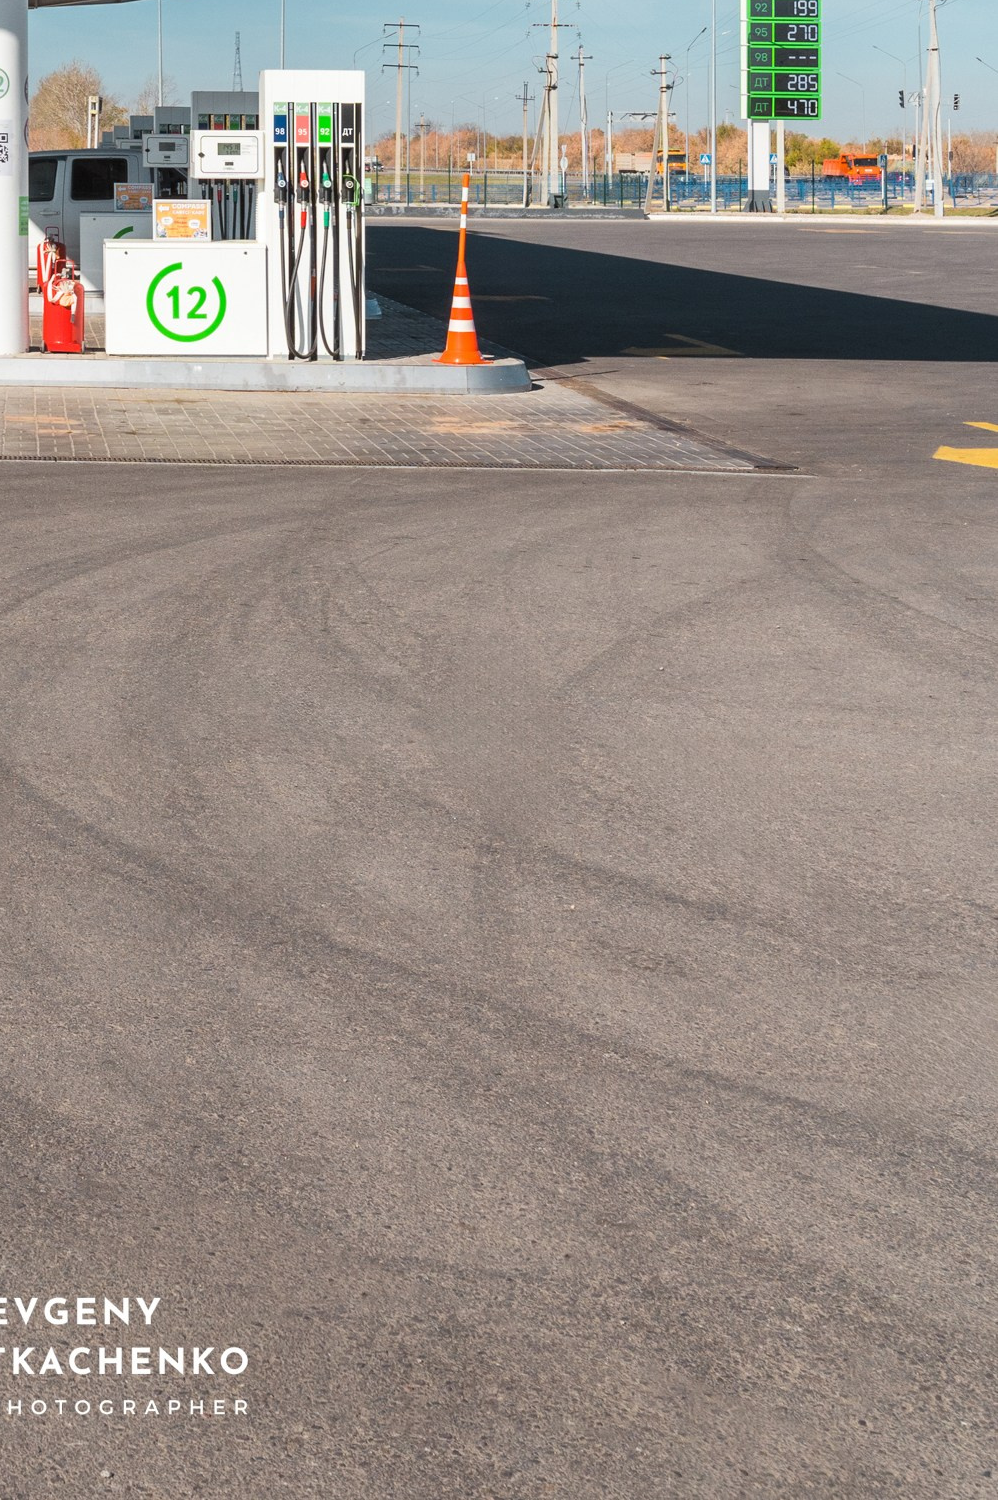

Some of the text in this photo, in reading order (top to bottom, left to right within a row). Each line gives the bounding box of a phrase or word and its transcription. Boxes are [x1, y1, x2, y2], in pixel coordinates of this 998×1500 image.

[754, 0, 818, 16] 92 199
[754, 25, 818, 41] 95 270
[754, 52, 768, 62] 98
[754, 74, 818, 91] ДТ 285
[754, 99, 818, 116] ДТ 470
[275, 127, 285, 135] 98
[297, 128, 308, 136] 95
[320, 127, 330, 135] 92
[342, 128, 354, 137] ДТ
[166, 285, 208, 319] 12
